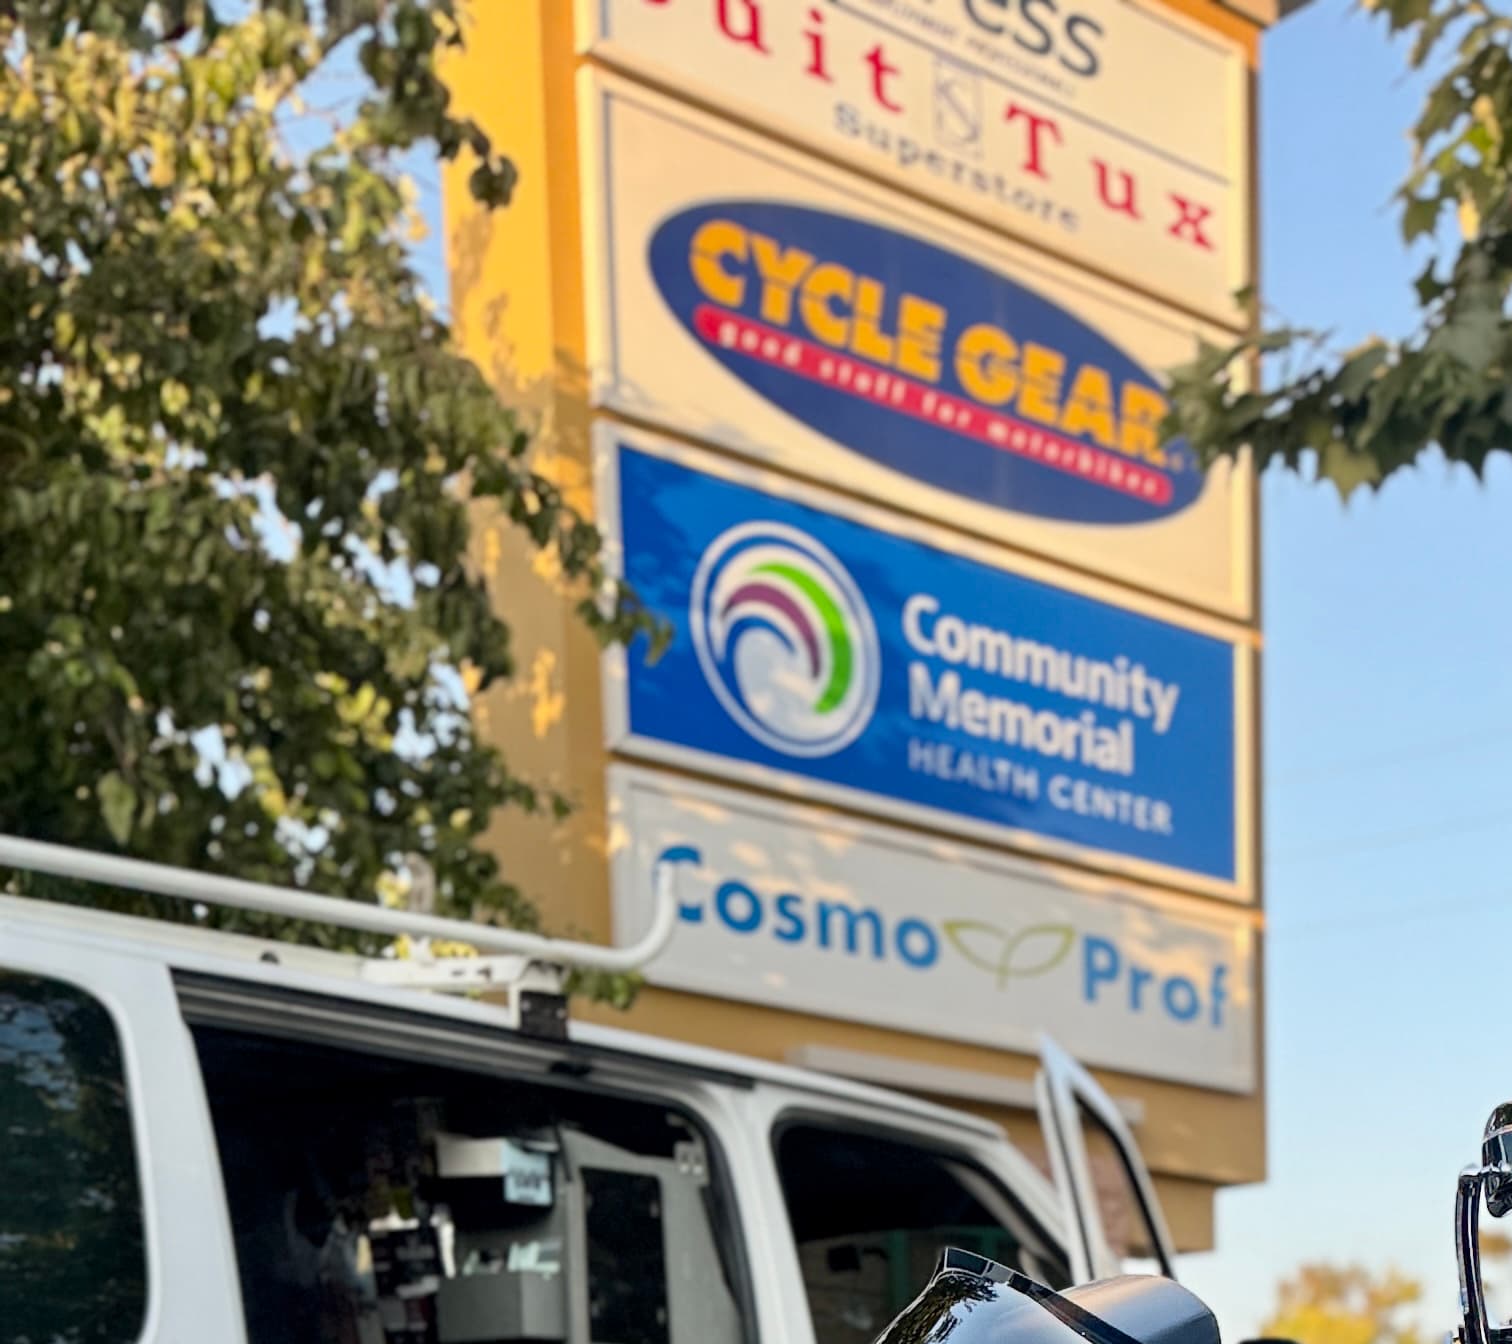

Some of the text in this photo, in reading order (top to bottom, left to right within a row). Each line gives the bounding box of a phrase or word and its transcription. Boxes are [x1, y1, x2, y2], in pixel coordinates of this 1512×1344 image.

[962, 0, 1104, 77] ess
[641, 0, 904, 113] uit
[1003, 101, 1215, 251] Tux
[835, 101, 1080, 232] Superstore
[689, 219, 1168, 467] CYCLE GEAR
[902, 593, 1180, 734] Community
[908, 661, 1134, 775] Memorial
[908, 737, 1173, 836] HEALTH CENTER
[1080, 934, 1231, 1029] Prof
